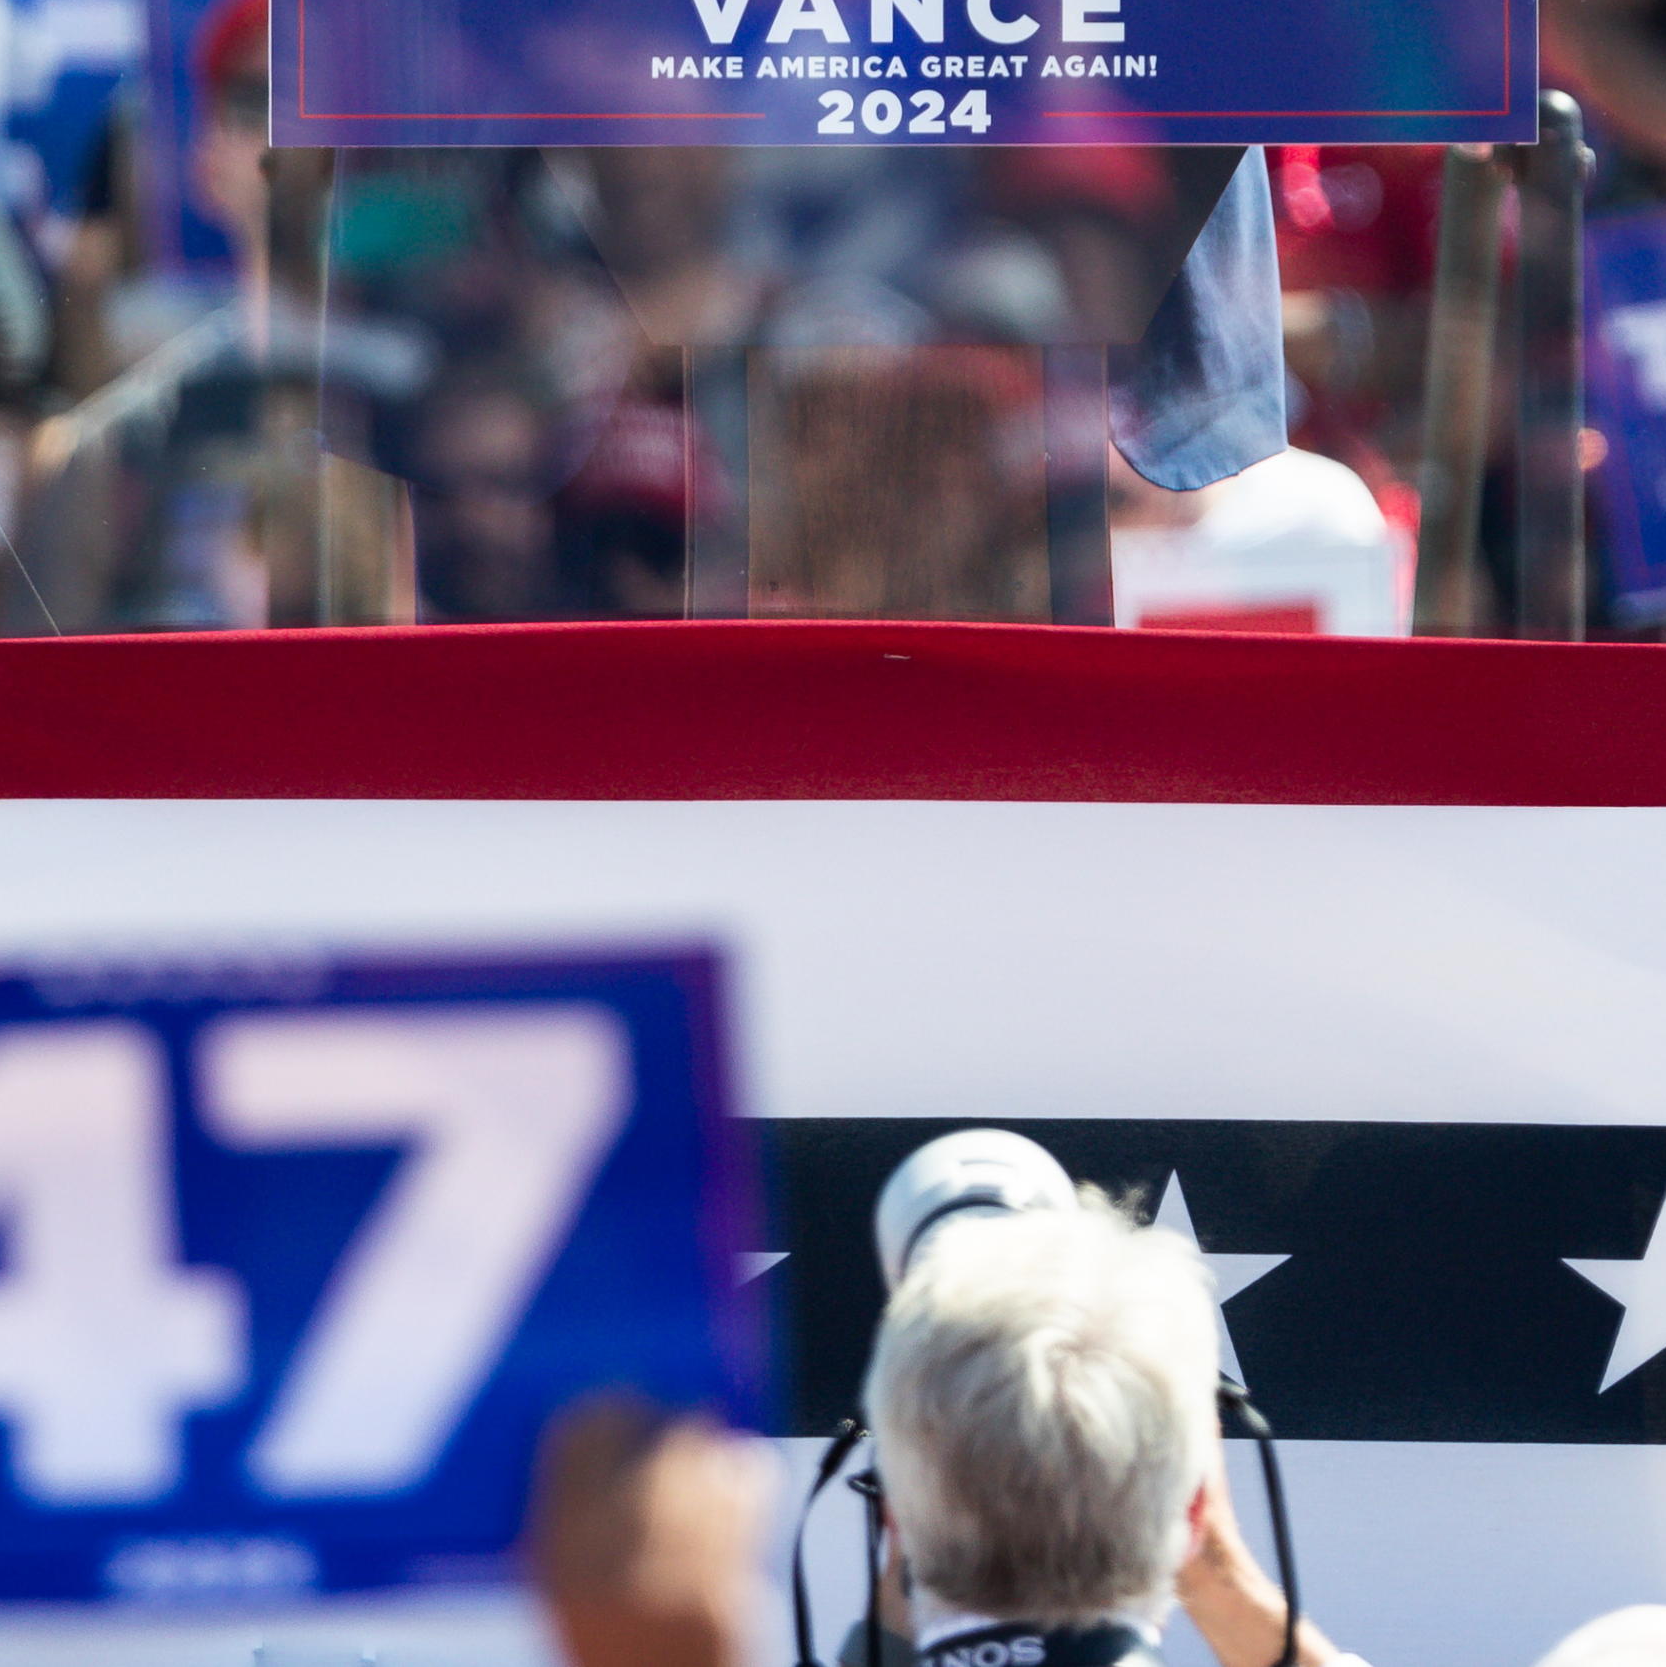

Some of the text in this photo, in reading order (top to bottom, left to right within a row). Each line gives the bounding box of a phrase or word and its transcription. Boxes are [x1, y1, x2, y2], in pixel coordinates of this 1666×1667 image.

[651, 54, 1158, 79] MAKE AMERICA GREAT AGAIN!
[817, 88, 993, 135] 2024
